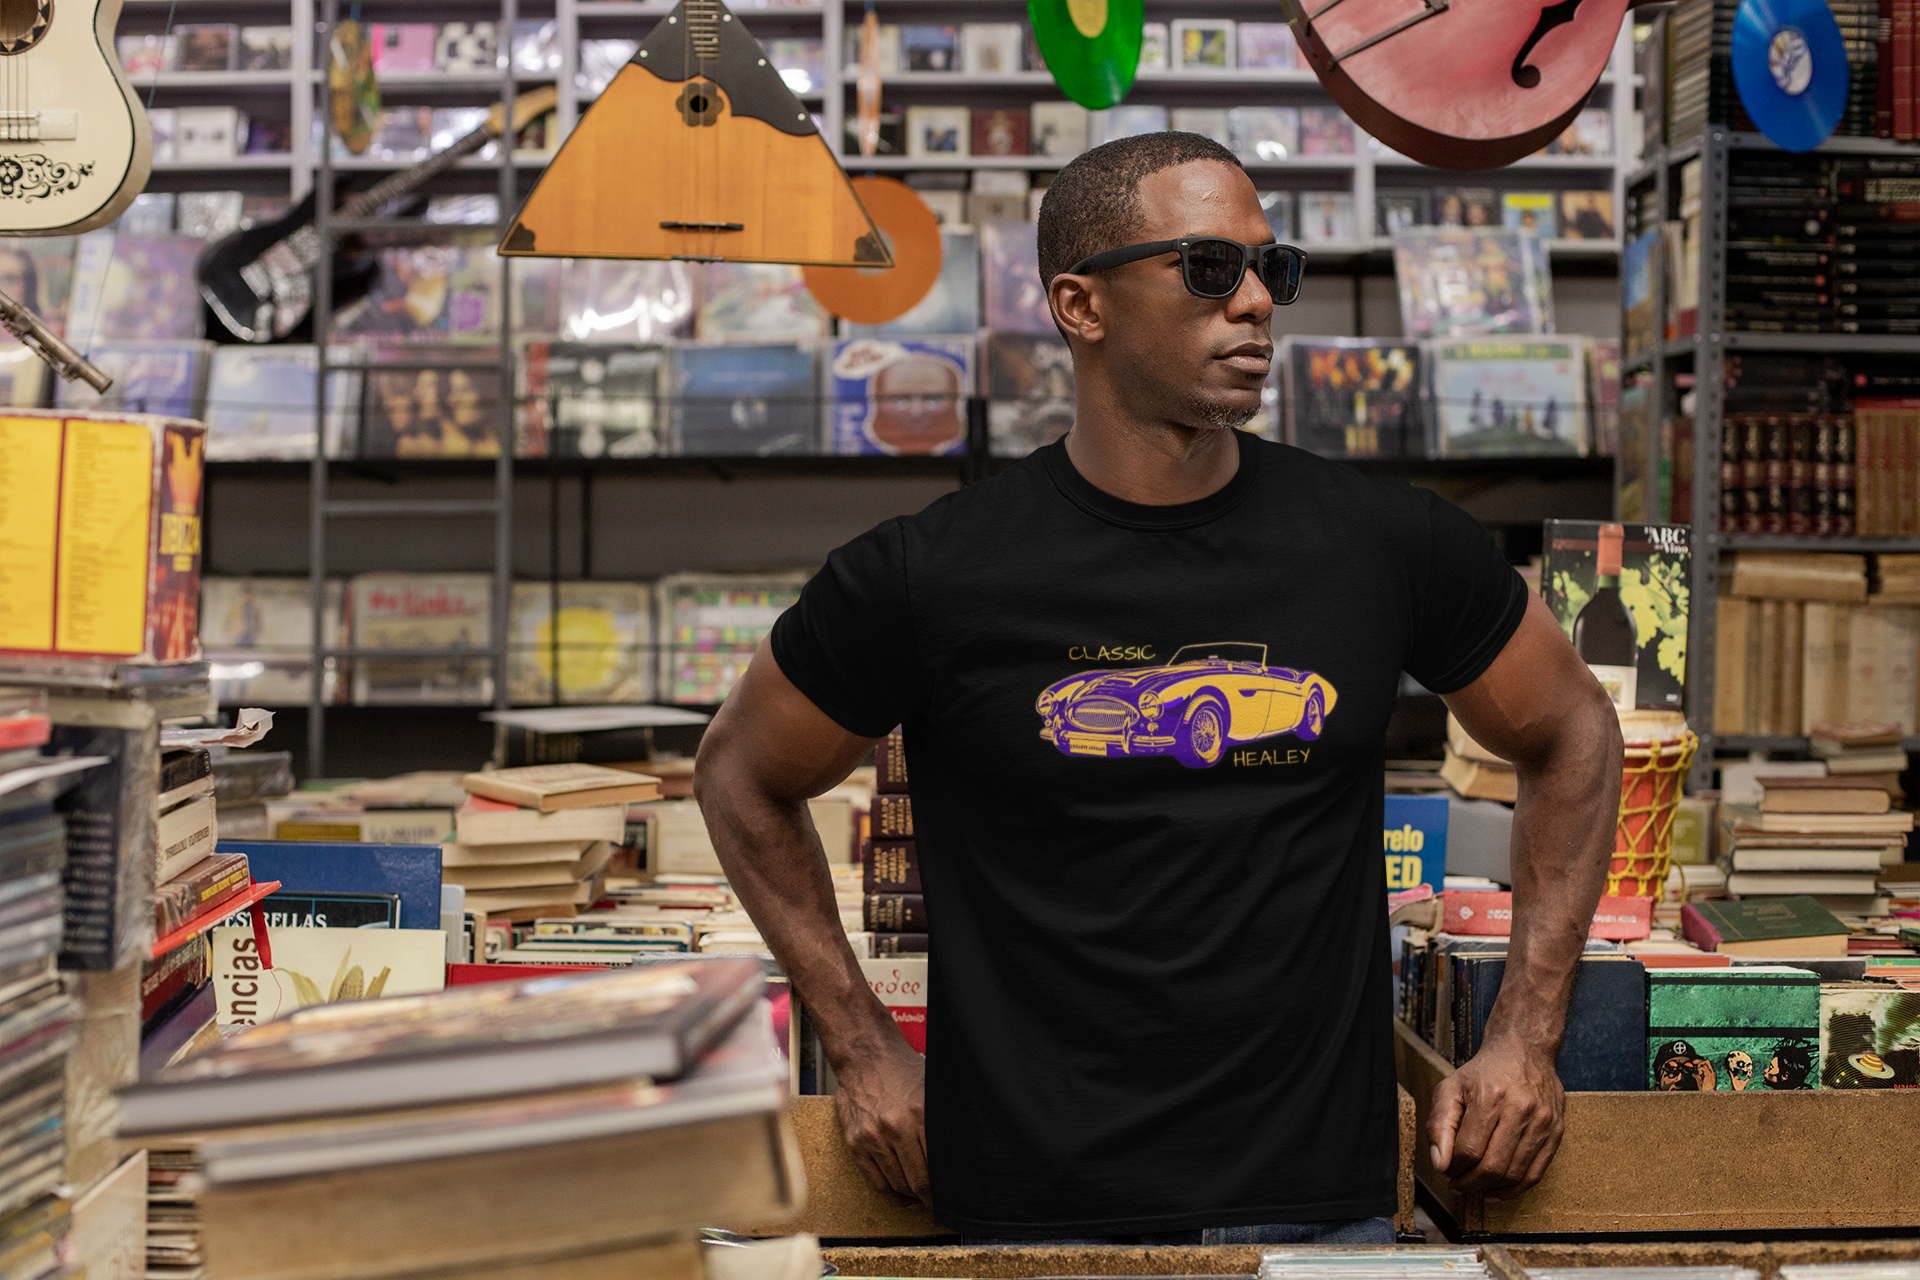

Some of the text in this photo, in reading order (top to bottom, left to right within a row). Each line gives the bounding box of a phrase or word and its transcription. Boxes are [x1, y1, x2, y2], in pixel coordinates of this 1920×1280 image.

[1309, 347, 1413, 391] KISS
[1068, 645, 1156, 661] CLASSIC
[1233, 748, 1310, 767] HEALEY
[881, 797, 889, 835] AMADO
[874, 847, 882, 884] AMADO
